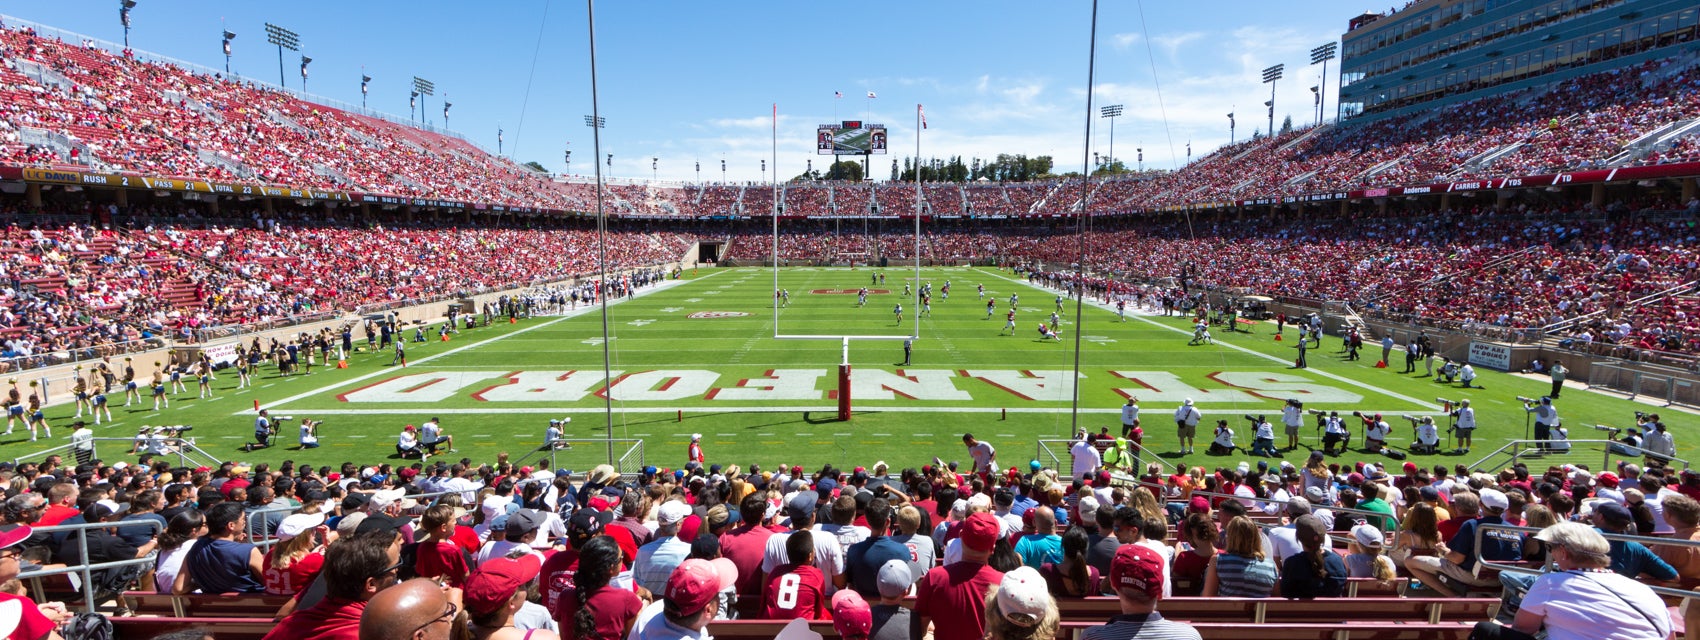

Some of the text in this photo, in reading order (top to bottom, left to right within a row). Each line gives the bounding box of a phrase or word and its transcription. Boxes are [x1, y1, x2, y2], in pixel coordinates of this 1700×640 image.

[45, 172, 76, 181] DAVIS
[84, 175, 128, 186] RUSH 2
[154, 180, 195, 190] PASS 21
[215, 185, 252, 194] TOTAL 23
[1455, 182, 1480, 190] CARRIES
[1403, 186, 1431, 195] Anderson
[1482, 351, 1507, 360] DOING?
[336, 369, 1364, 403] STANFORD
[265, 569, 295, 594] 21
[1121, 577, 1146, 589] STANFORD
[777, 573, 801, 610] 8
